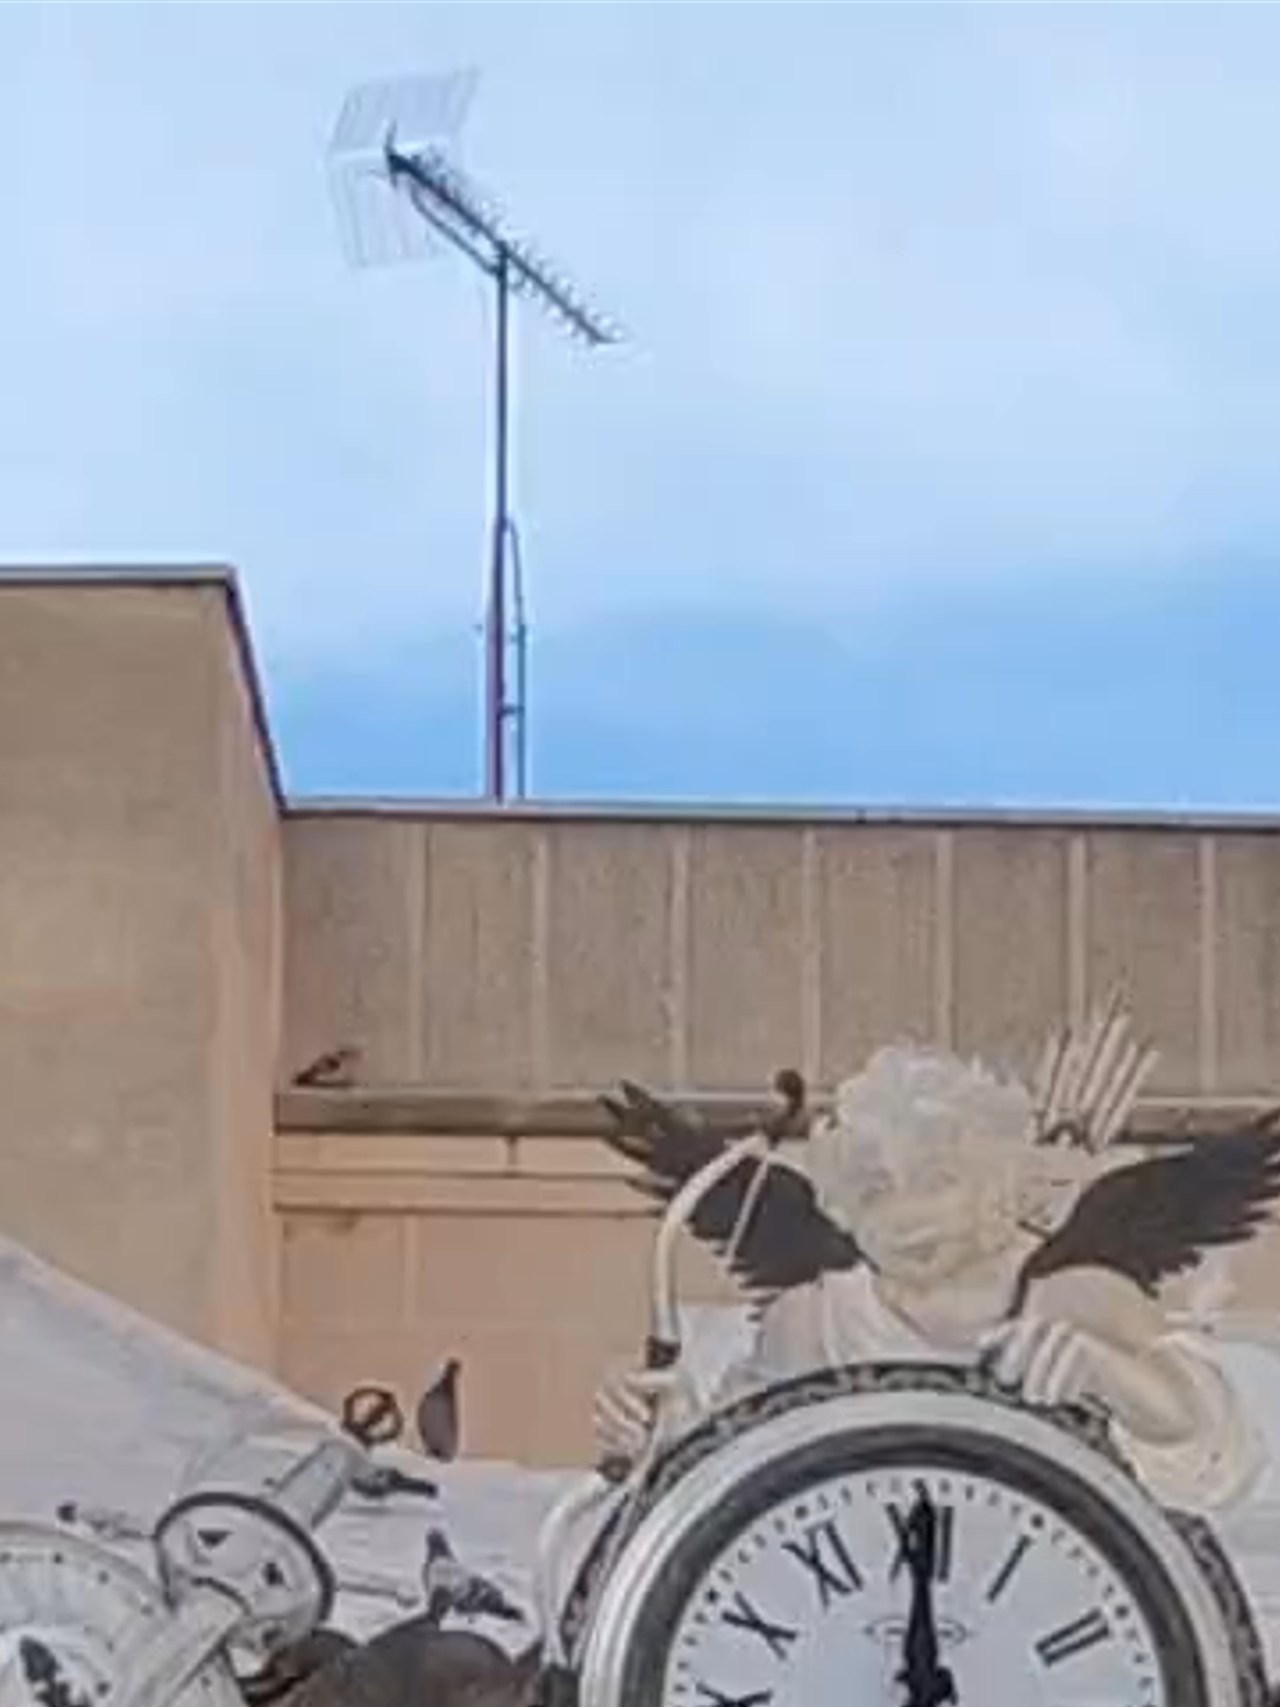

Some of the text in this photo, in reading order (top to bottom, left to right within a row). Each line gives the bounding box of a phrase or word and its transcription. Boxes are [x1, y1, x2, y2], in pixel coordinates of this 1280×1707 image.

[781, 1519, 863, 1612] XI
[986, 1534, 1032, 1602] I
[722, 1590, 798, 1662] X
[1034, 1606, 1110, 1668] II
